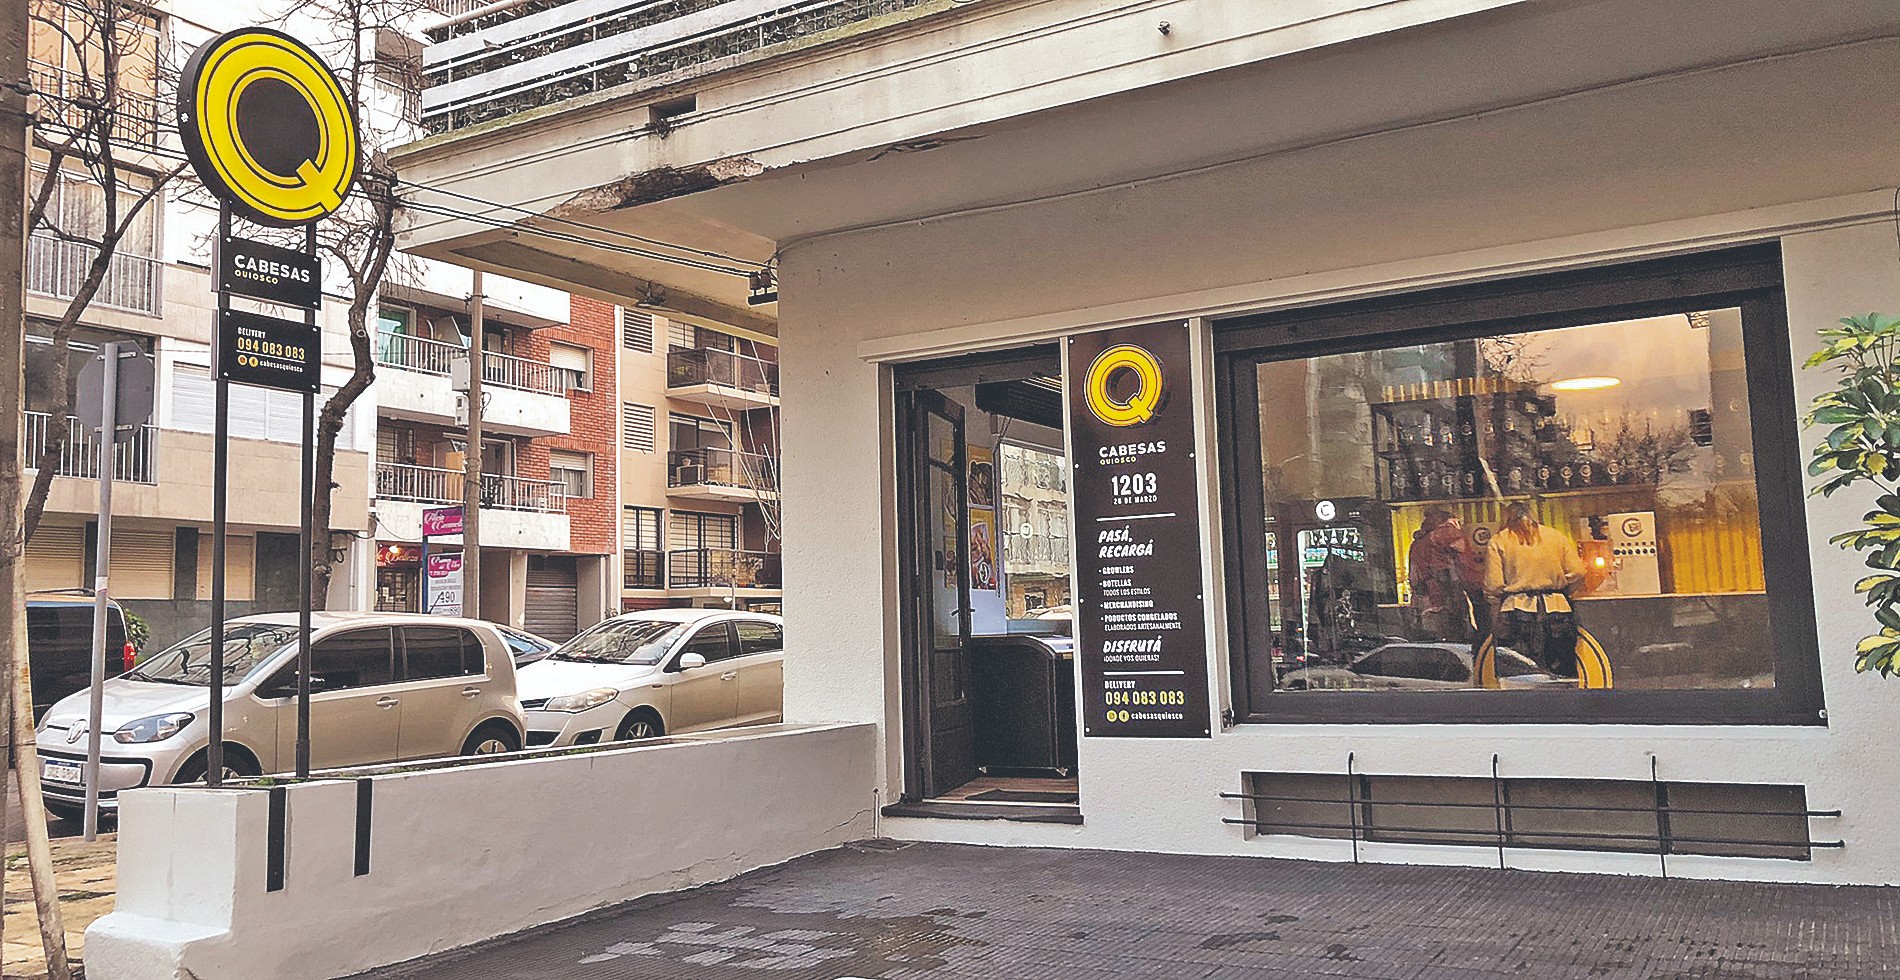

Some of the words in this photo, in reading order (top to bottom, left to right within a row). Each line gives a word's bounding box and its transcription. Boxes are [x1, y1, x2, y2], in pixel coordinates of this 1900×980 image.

[234, 254, 310, 282] CABESAS
[234, 270, 278, 284] QUIOSCO
[238, 326, 266, 338] DELIVERY
[238, 336, 260, 352] 094
[262, 342, 282, 356] 083
[286, 346, 304, 360] 083
[260, 360, 302, 372] cabesasquiosco
[1100, 440, 1166, 458] CABESAS
[1100, 456, 1136, 466] QUIOSCO
[1112, 472, 1156, 496] 1203
[1098, 538, 1154, 558] RECARGÁ
[1102, 566, 1134, 574] GROWLERS
[1102, 580, 1132, 588] BOTELLAS
[1130, 588, 1150, 596] ESTILOS
[1104, 600, 1154, 608] MERCHANDISING
[1138, 612, 1178, 620] CONGELADOS
[1104, 624, 1136, 632] ELABORADOS
[1138, 622, 1182, 630] ARTESANALMENTE
[1102, 634, 1162, 654] DISFRUTÁ
[1104, 680, 1136, 688] DELIVERY
[1106, 690, 1130, 706] 094
[1132, 690, 1156, 706] 083
[1160, 690, 1184, 706] 083
[1130, 712, 1184, 720] cabesasquiosco
